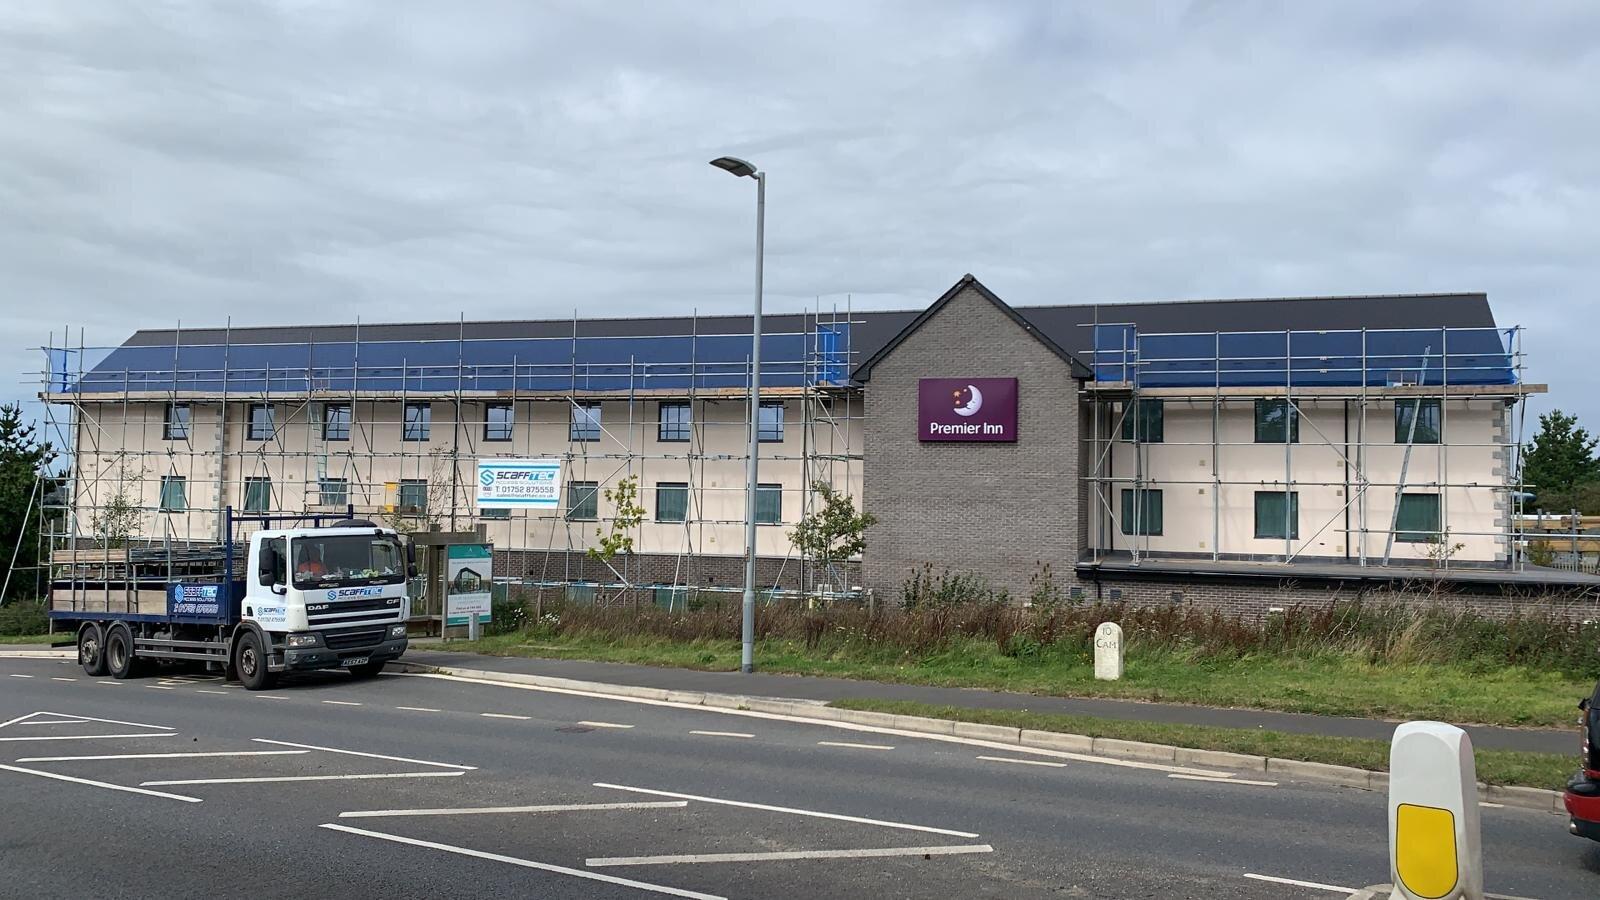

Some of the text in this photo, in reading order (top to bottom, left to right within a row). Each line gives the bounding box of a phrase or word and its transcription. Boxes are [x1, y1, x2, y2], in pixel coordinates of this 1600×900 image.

[930, 422, 1004, 434] Premier Inn
[1102, 626, 1112, 636] 10
